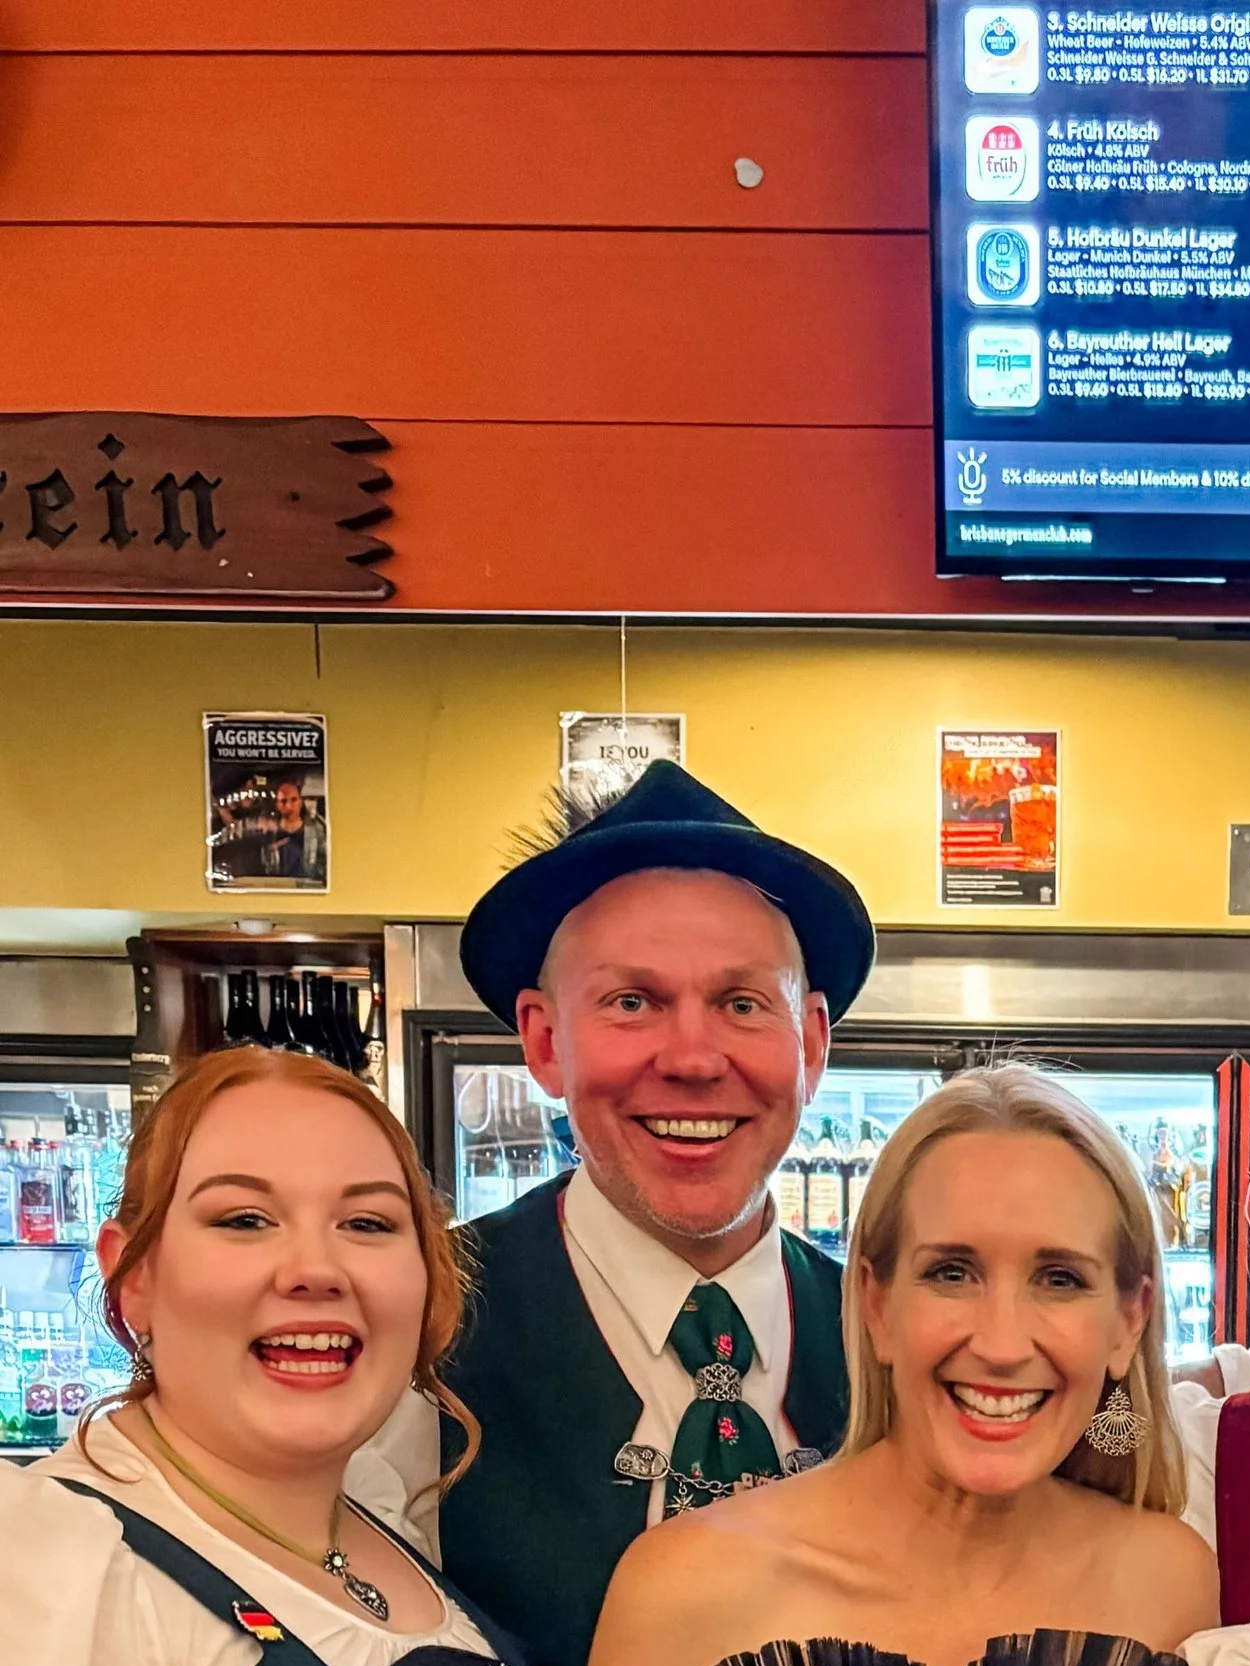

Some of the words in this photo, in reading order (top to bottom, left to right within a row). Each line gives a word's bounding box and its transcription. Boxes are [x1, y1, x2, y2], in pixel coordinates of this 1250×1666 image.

[1047, 12, 1064, 32] 3.
[1067, 12, 1148, 33] Schneider
[1151, 12, 1208, 34] Weisse
[1048, 35, 1084, 48] Wheat
[1086, 35, 1114, 48] Beer
[1124, 35, 1190, 49] Hefeweizen
[1047, 121, 1064, 139] 4.
[1067, 121, 1103, 141] Früh
[1106, 121, 1160, 141] Kölsch
[1048, 143, 1085, 157] Kölsch
[1125, 144, 1150, 157] ABV
[986, 156, 1018, 173] früh
[1048, 228, 1064, 247] 5.
[1067, 228, 1130, 248] Hofbräu
[1133, 229, 1186, 249] Dunkel
[1189, 229, 1236, 250] Lager
[1048, 249, 1080, 264] Lager
[1090, 249, 1131, 262] Munich
[1133, 250, 1171, 263] Dunkel
[1181, 251, 1208, 264] 5.5%
[1210, 249, 1234, 264] ABV
[1048, 332, 1064, 350] 6.
[1067, 332, 1150, 353] Bayreuther
[1152, 332, 1182, 351] Hell
[1185, 333, 1232, 353] Lager
[1048, 352, 1080, 367] Lager
[1133, 353, 1160, 366] 4.9%
[1162, 354, 1186, 366] ABV
[1002, 470, 1021, 483] 5%
[1023, 471, 1077, 484] discount
[1080, 470, 1097, 484] for
[1101, 471, 1138, 485] Social
[1141, 471, 1198, 486] Members
[1202, 472, 1211, 486] &
[1214, 472, 1238, 486] 10%
[0, 433, 226, 551] ein
[214, 730, 320, 747] AGGRESSIVE?
[217, 748, 236, 758] YOU
[236, 749, 266, 758] WON'T
[624, 745, 649, 759] OU
